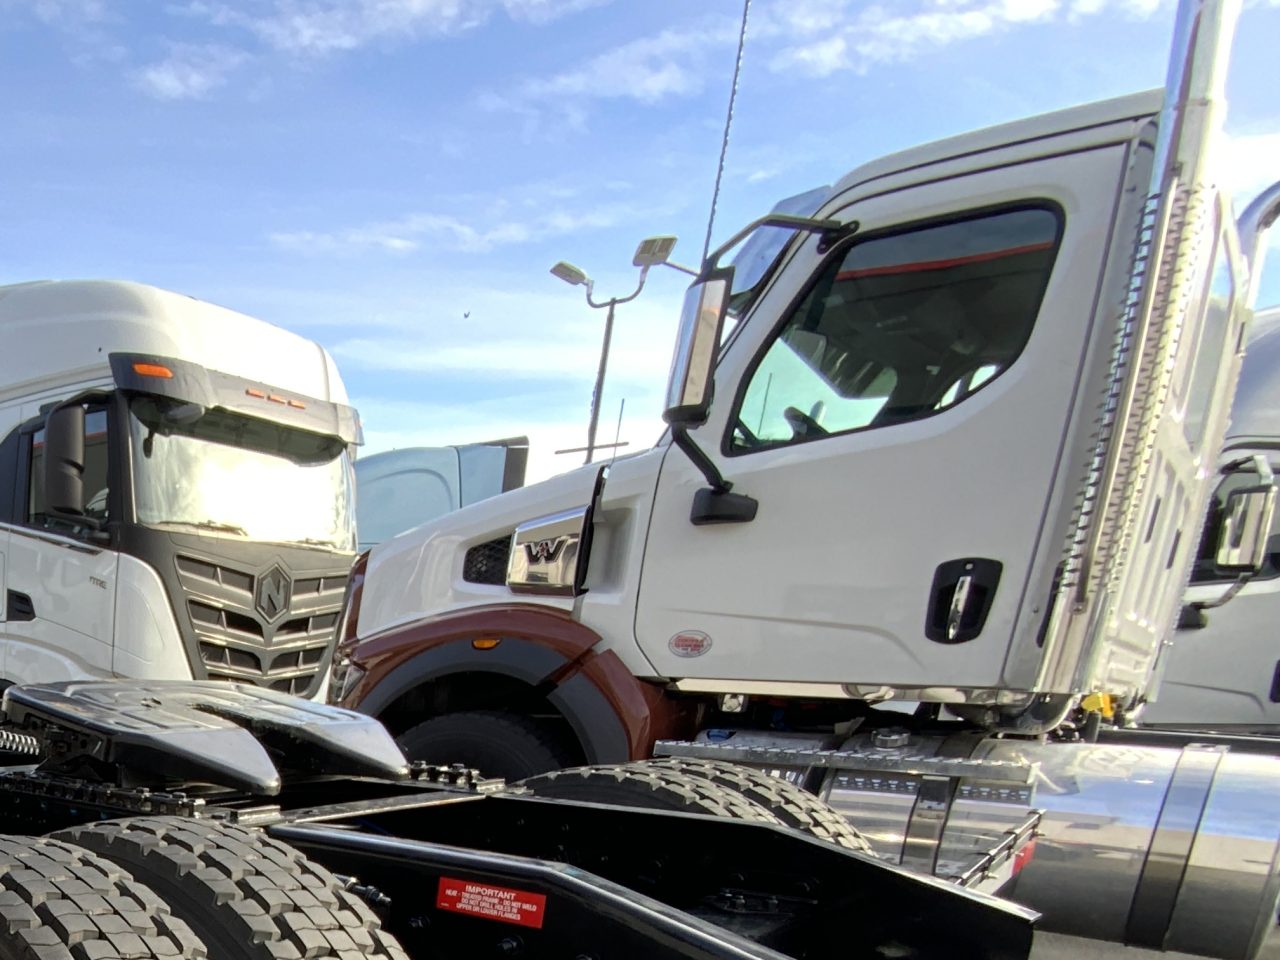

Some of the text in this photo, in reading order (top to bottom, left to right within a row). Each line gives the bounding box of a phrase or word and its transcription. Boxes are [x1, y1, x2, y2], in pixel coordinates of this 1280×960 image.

[465, 885, 517, 900] IMPORTANT
[456, 902, 472, 911] UPPER
[472, 905, 480, 913] OR
[480, 907, 498, 916] LOWER
[498, 910, 521, 920] FLANGES
[480, 901, 494, 909] DRILL
[494, 903, 511, 912] HOLES
[482, 894, 499, 904] FRAME
[511, 901, 522, 909] NOT
[522, 902, 537, 912] WELD
